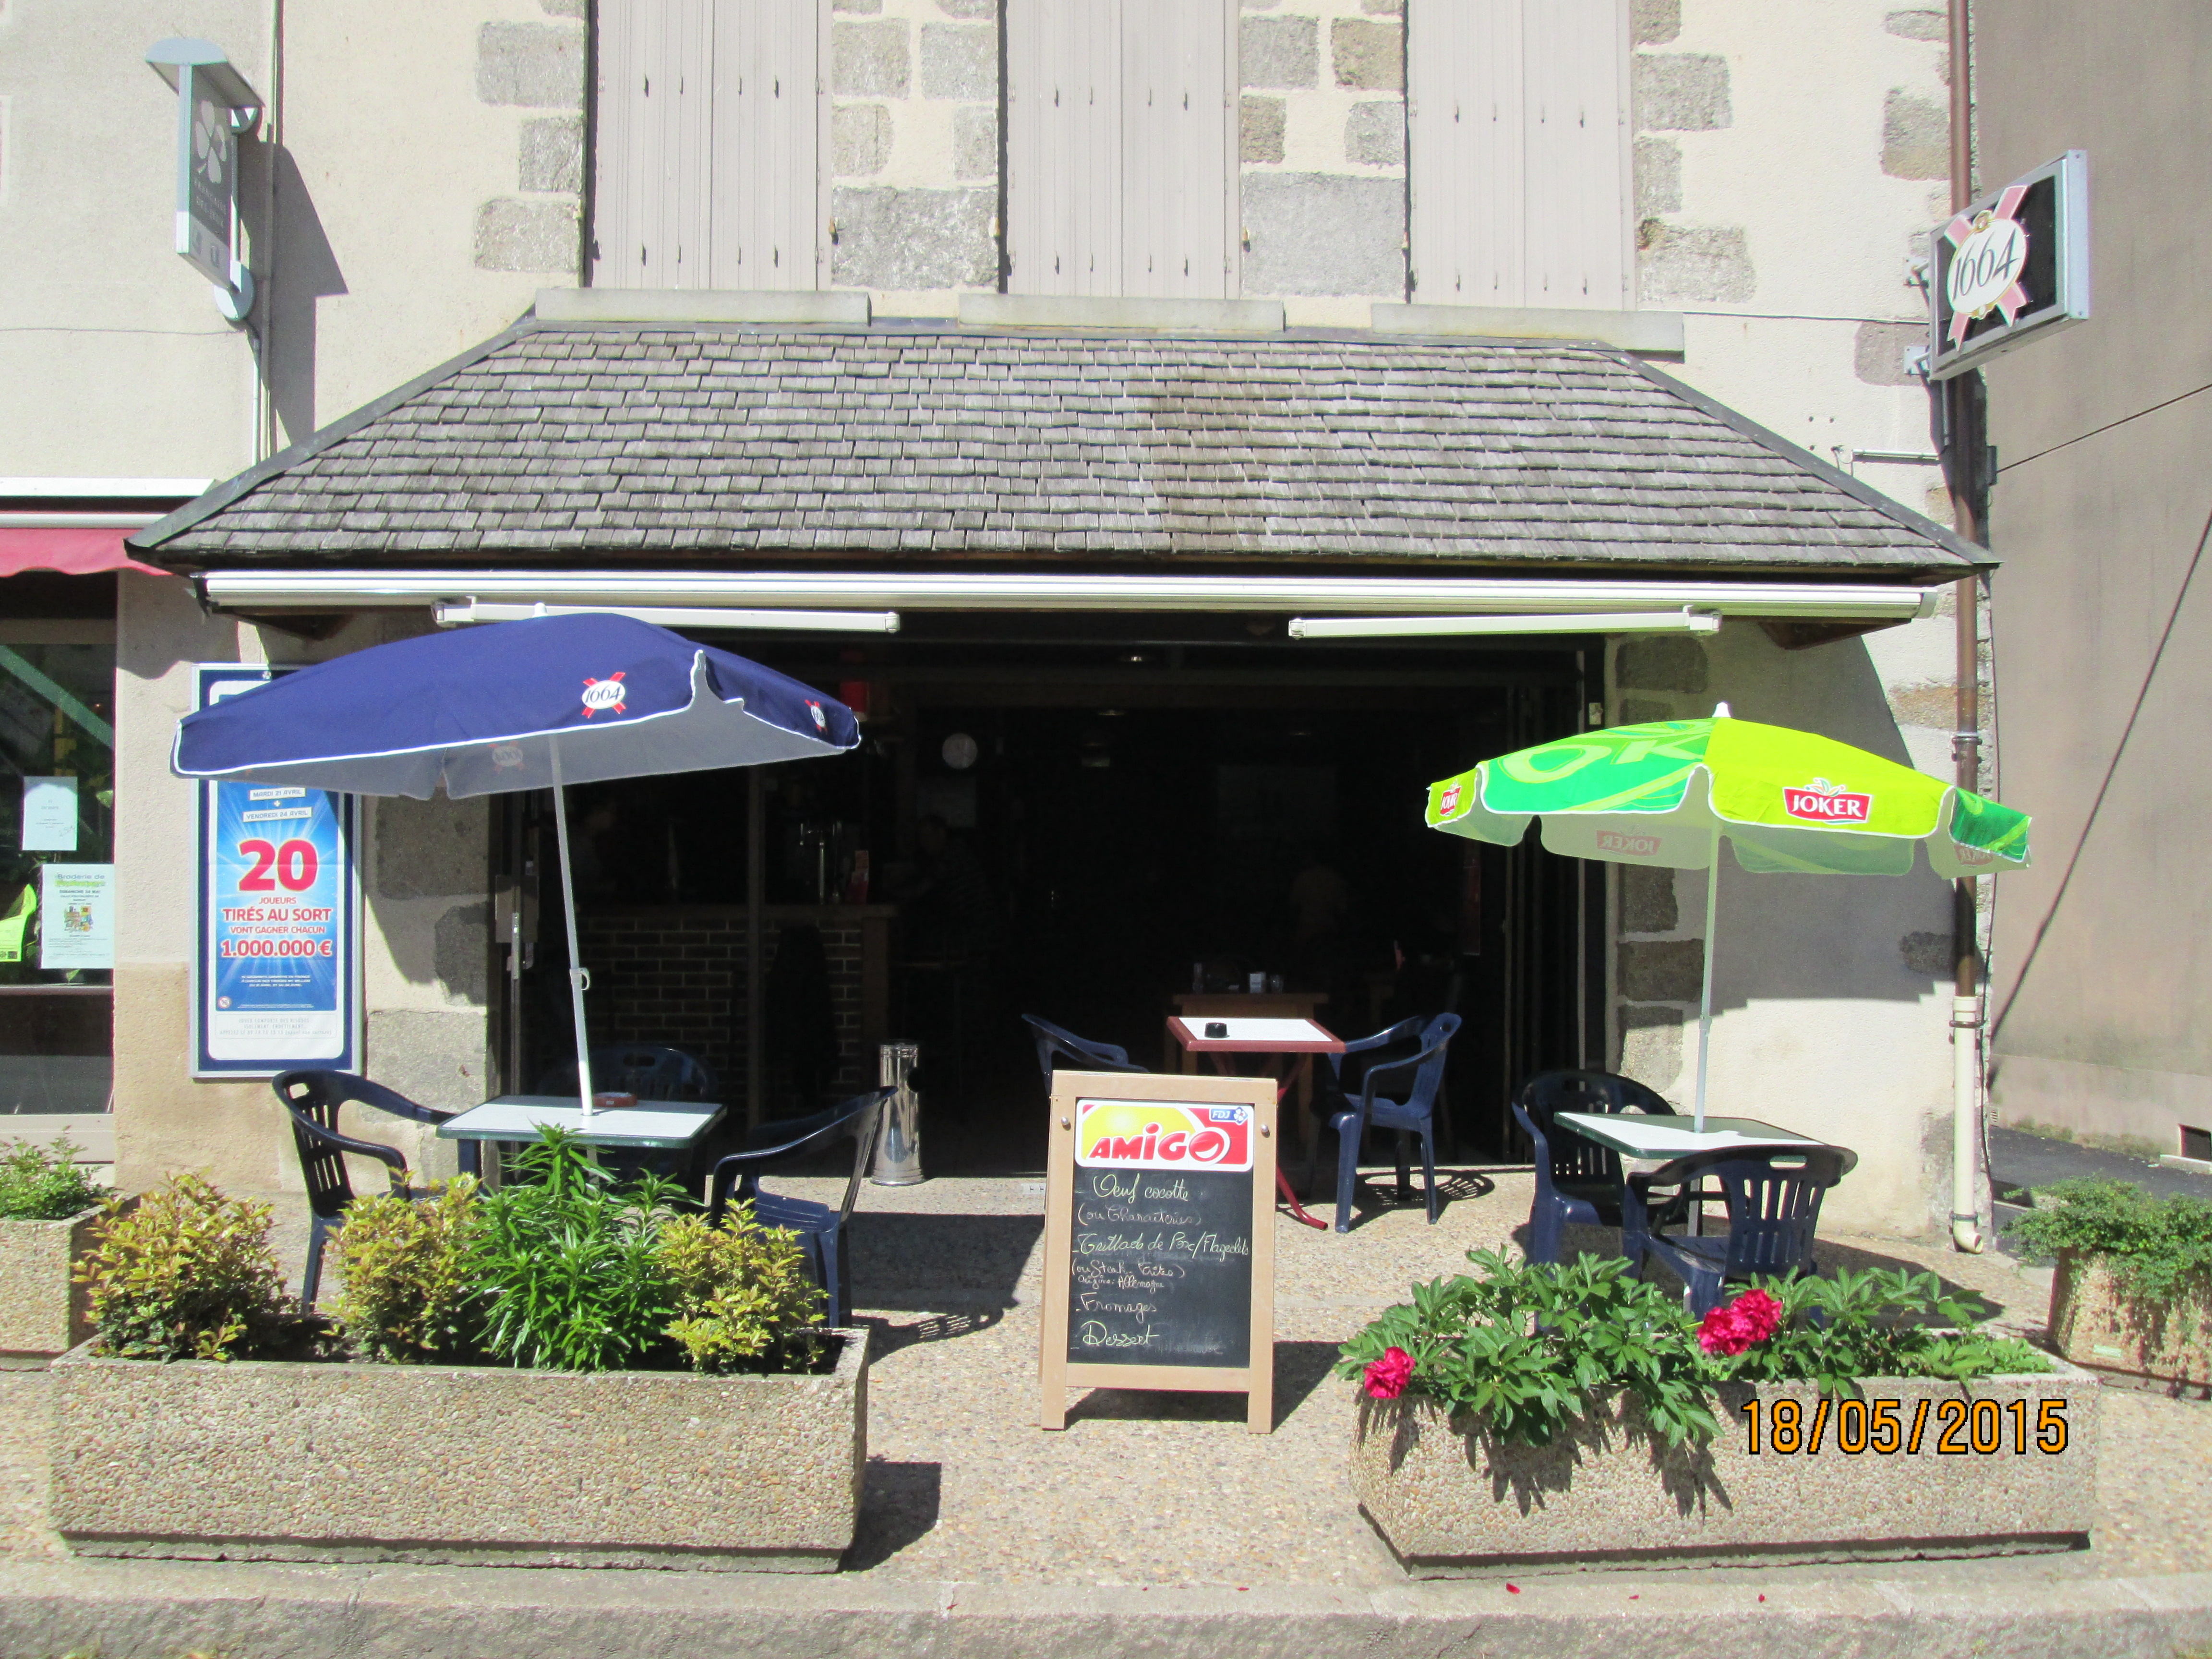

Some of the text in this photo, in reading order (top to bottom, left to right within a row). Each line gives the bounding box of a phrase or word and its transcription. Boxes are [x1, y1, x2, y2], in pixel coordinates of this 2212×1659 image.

[1952, 228, 2019, 301] 1664
[585, 684, 624, 703] 1664
[1791, 795, 1863, 817] JOKER
[239, 839, 318, 891] 20
[222, 906, 332, 921] TIRÉS AU SORT
[222, 939, 332, 956] 1.000.000 €
[1212, 1110, 1230, 1119] FDJ
[1088, 1123, 1225, 1162] AMIGO
[1144, 1178, 1189, 1201] cocotte
[1148, 1232, 1164, 1250] de
[1080, 1321, 1160, 1347] Dessert
